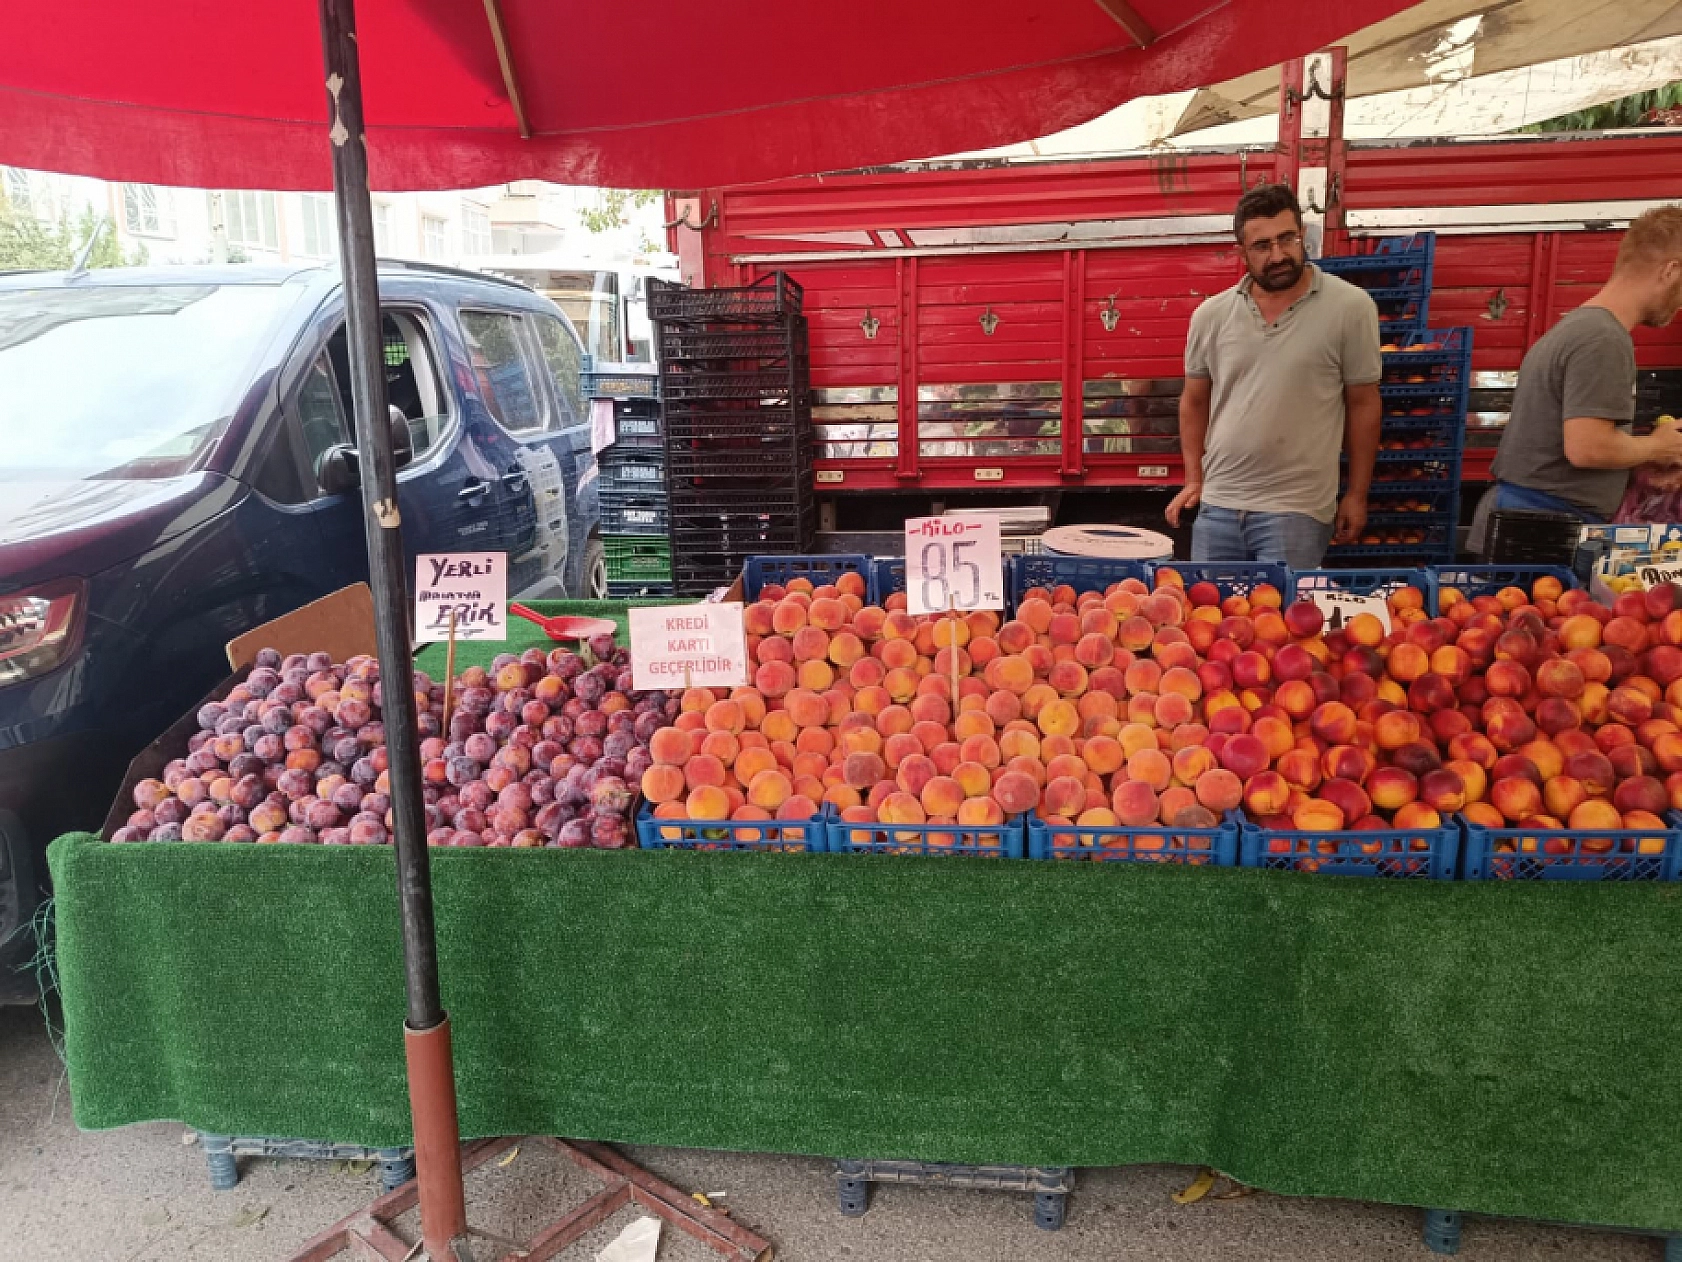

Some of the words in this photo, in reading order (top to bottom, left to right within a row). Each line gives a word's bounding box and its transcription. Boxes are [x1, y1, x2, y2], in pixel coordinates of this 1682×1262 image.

[921, 540, 980, 611] 85
[666, 614, 709, 631] KREDİ
[667, 638, 709, 651] KARTI
[649, 656, 732, 676] GEÇERLİDİR
